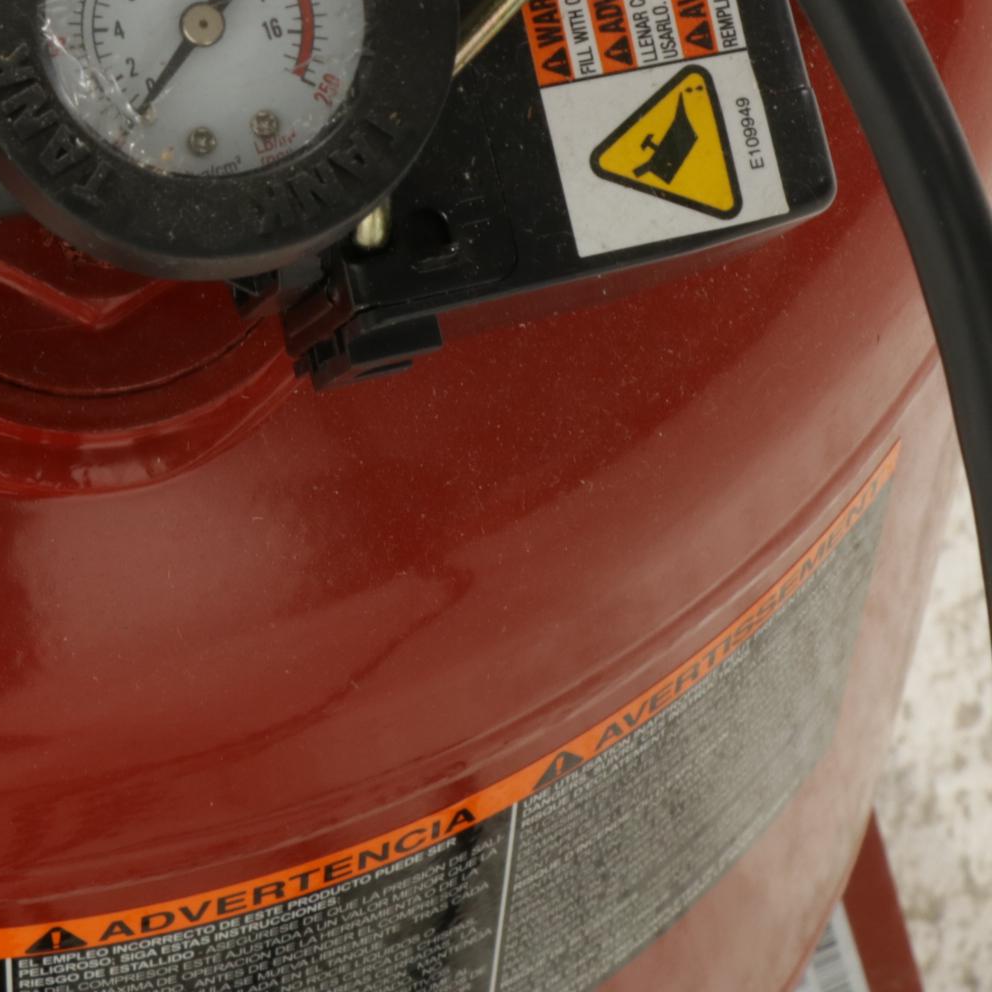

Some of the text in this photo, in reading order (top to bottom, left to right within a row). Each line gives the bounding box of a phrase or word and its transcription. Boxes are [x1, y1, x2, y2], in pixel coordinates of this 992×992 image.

[113, 20, 126, 41] 4
[261, 17, 283, 41] 16
[569, 11, 590, 45] WITH
[636, 10, 658, 63] LLENAR
[652, 1, 678, 58] USARLO.
[125, 57, 139, 78] 2
[580, 48, 598, 75] FILL
[313, 72, 342, 107] 250
[736, 96, 765, 171] E109949
[98, 807, 476, 943] ADVERTENCIA
[18, 834, 456, 969] EL EMPLEO INCORRECTO DE ESTE PRODUCTO PUEDE SER
[18, 972, 81, 990] RIESGO
[83, 968, 106, 982] DE
[109, 950, 196, 976] ESTALLIDO
[361, 889, 380, 905] LA
[78, 965, 179, 991] COMPRESOR
[224, 928, 301, 960] AJUSTADA
[341, 896, 388, 924] VALOR
[120, 947, 158, 964] SIGA
[161, 935, 212, 955] ESTAS
[298, 933, 317, 948] LA
[194, 967, 244, 989] ANTES
